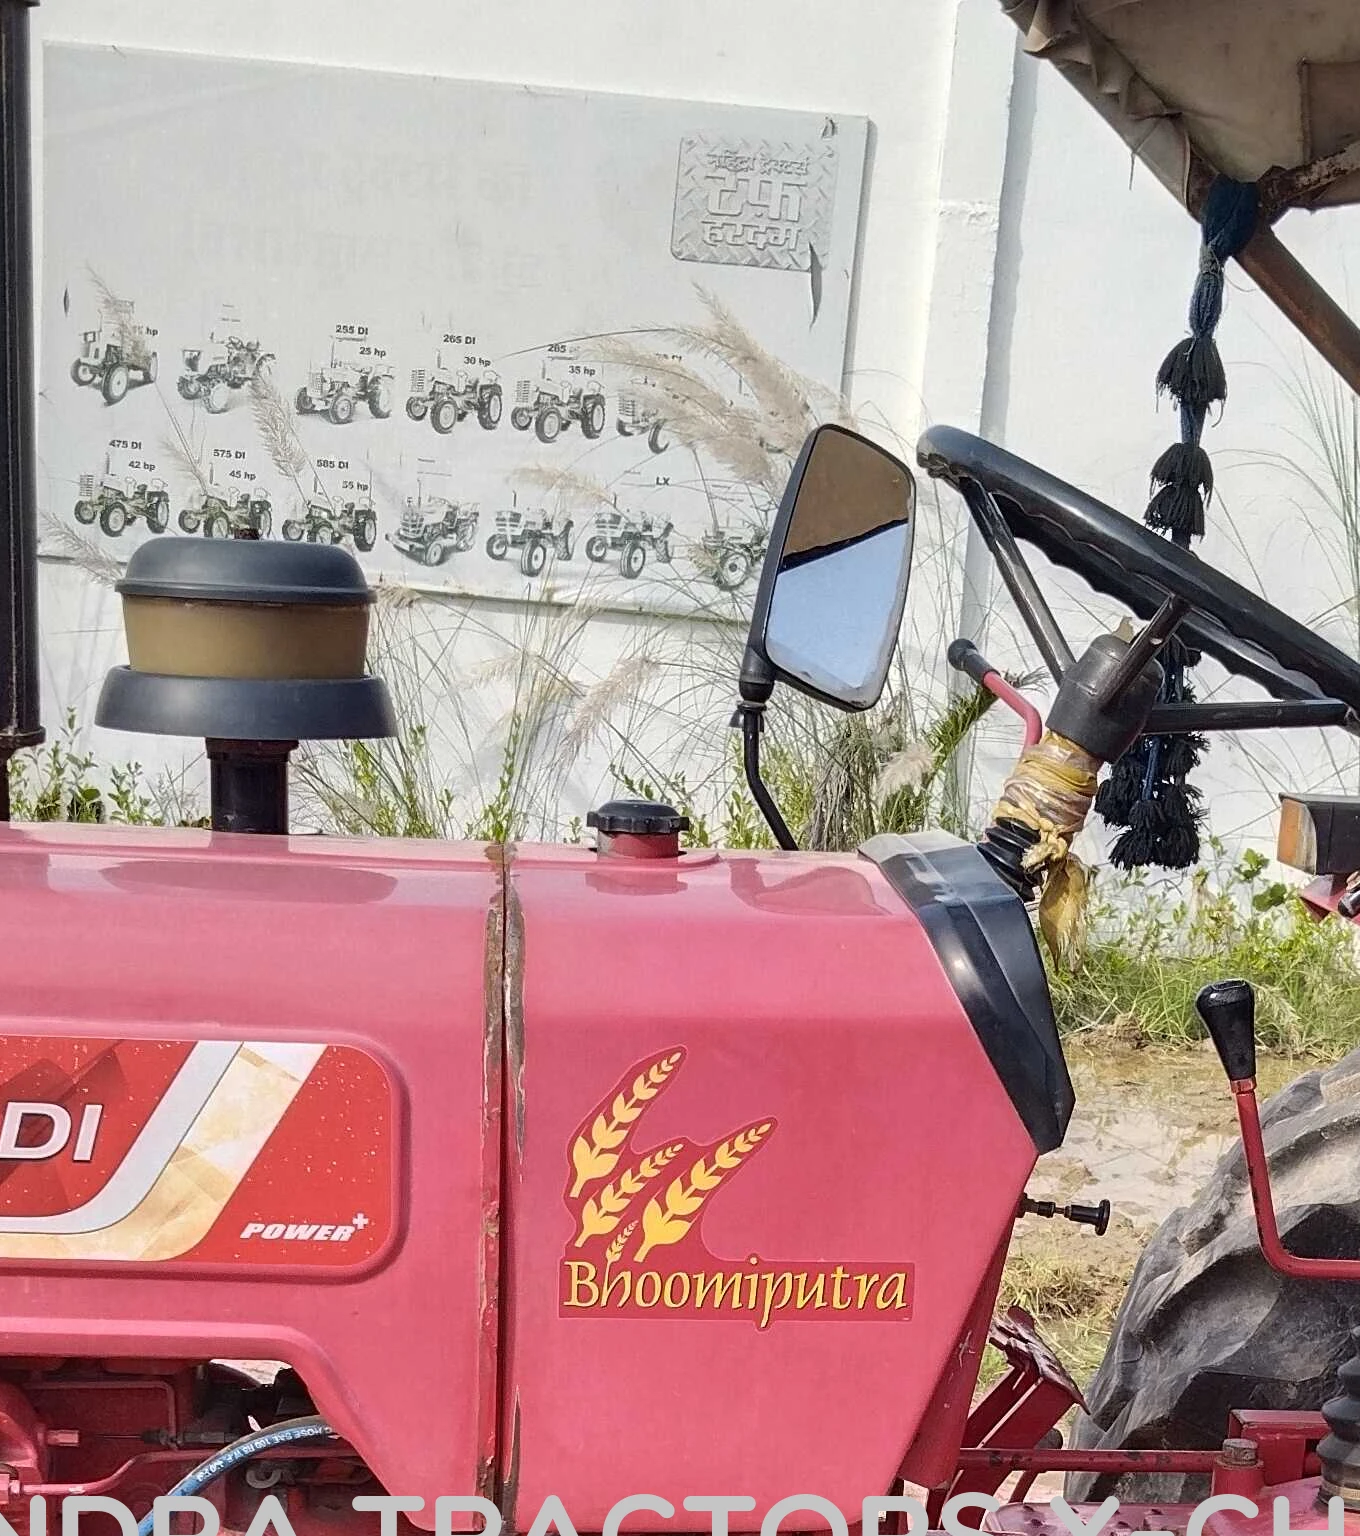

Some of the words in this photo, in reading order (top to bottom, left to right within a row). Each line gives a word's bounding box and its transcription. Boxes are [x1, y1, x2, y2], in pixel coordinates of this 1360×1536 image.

[335, 324, 355, 334] 255
[357, 325, 369, 335] DI
[443, 334, 462, 344] 265
[464, 335, 476, 345] DI
[359, 346, 372, 356] 25
[374, 347, 387, 358] hp
[478, 357, 491, 368] hp
[568, 365, 581, 375] 35
[583, 366, 596, 377] hp
[108, 439, 129, 449] 475
[131, 440, 142, 450] DI
[213, 449, 232, 459] 575
[234, 450, 246, 460] DI
[128, 460, 141, 470] 42
[316, 459, 335, 469] 585
[229, 470, 241, 479] 45
[243, 471, 256, 482] hp
[655, 476, 671, 486] LX
[356, 481, 369, 492] hp
[562, 1252, 910, 1328] Bhoomiputra
